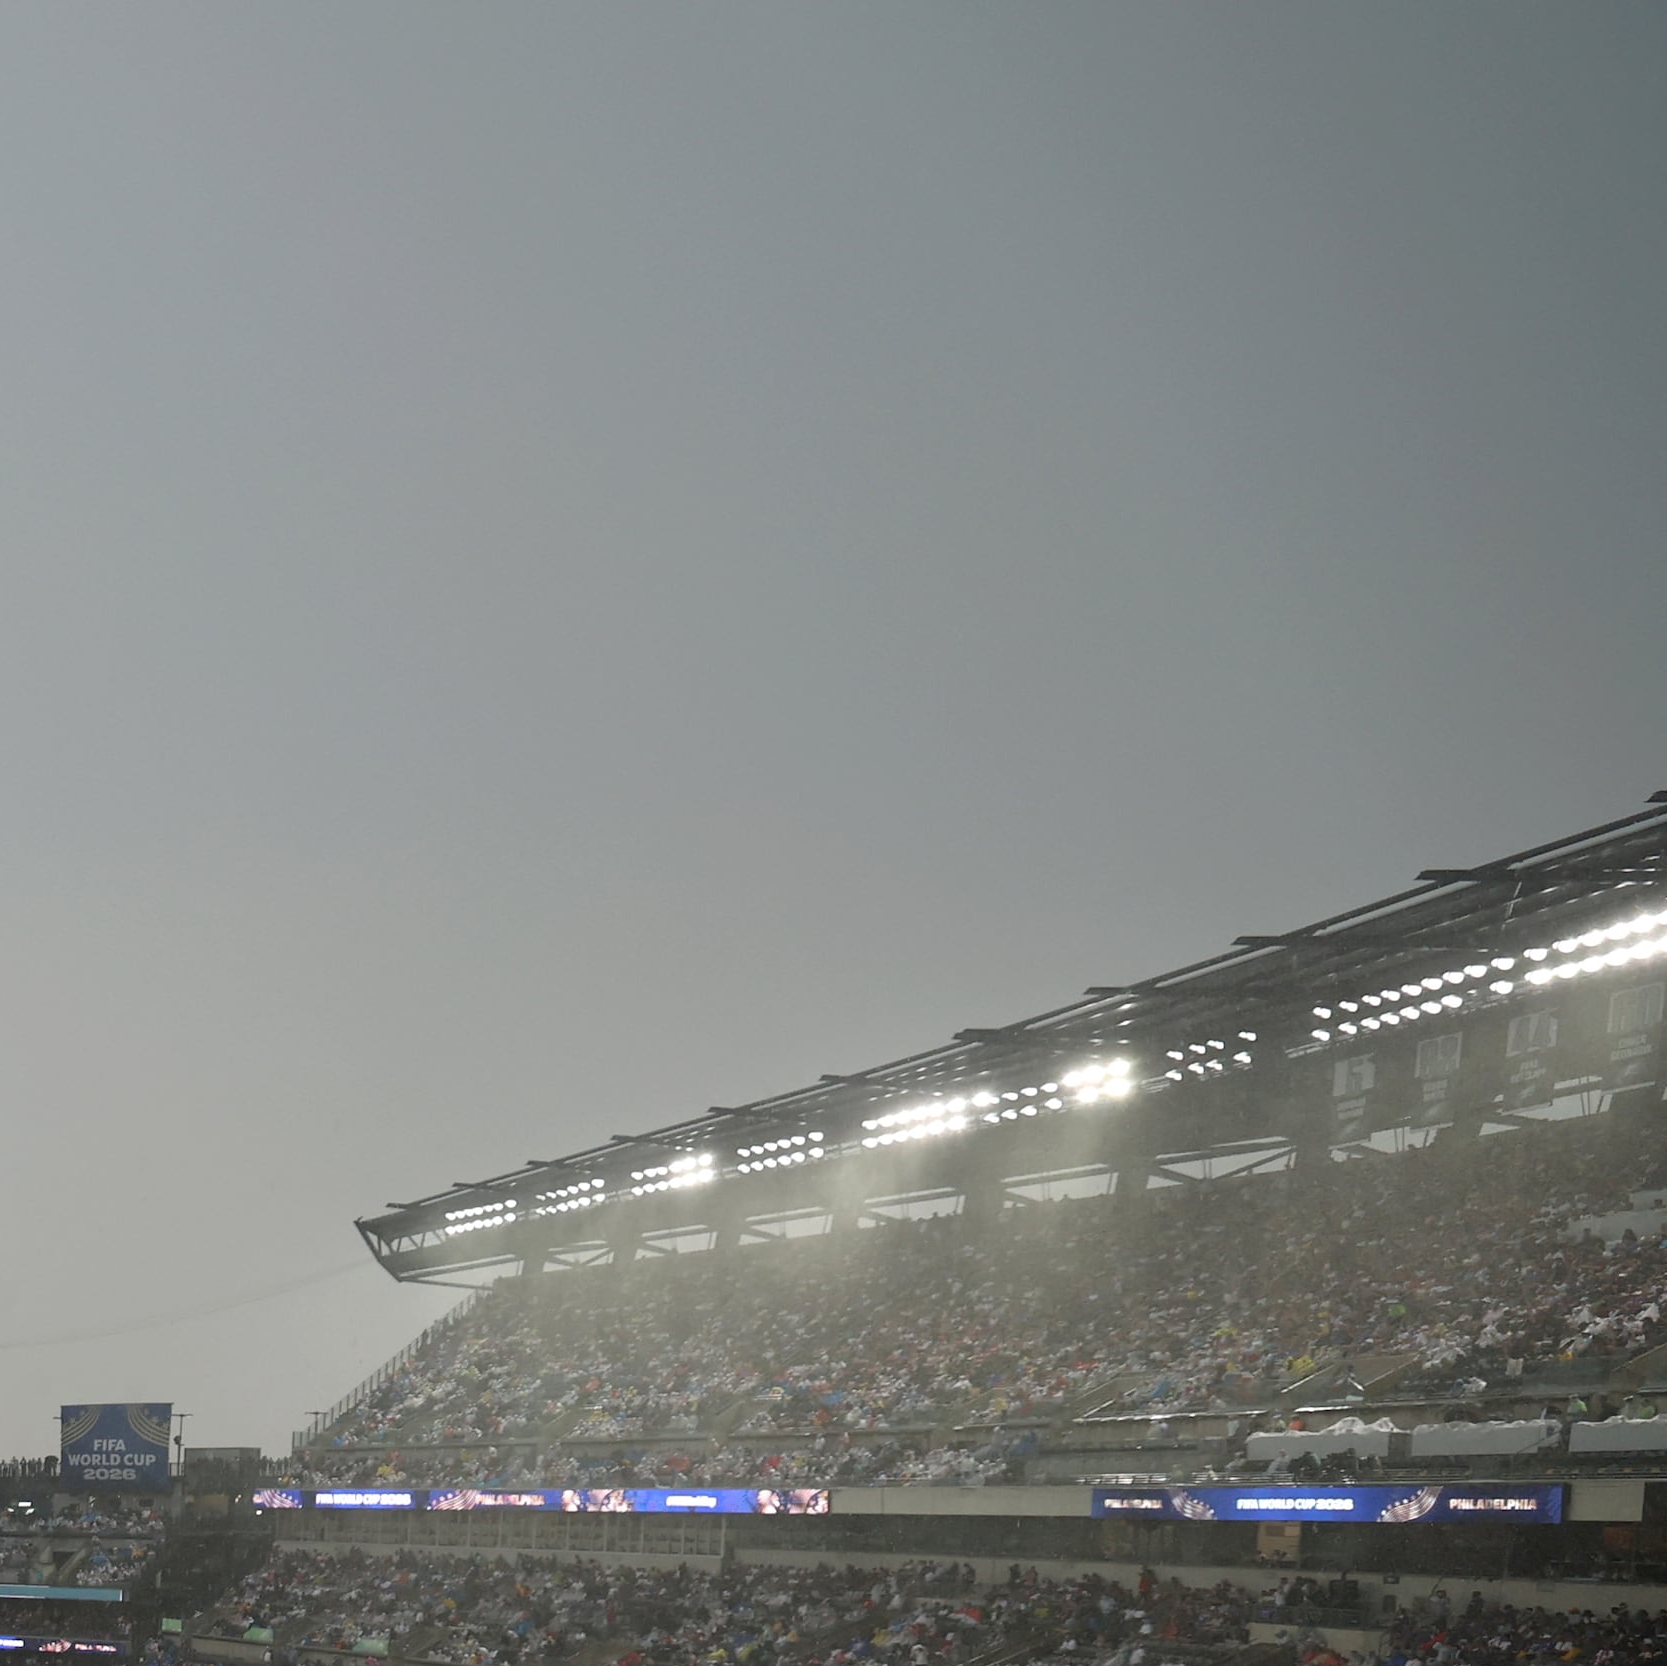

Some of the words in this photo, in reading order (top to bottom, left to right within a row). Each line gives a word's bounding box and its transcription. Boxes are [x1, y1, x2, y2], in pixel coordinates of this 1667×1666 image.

[94, 1439, 126, 1452] FIFA
[68, 1453, 124, 1467] WORLD
[126, 1453, 157, 1467] CUP
[83, 1468, 137, 1481] 2026
[1236, 1499, 1258, 1510] FIFA
[1258, 1499, 1294, 1510] WORLD
[1295, 1499, 1315, 1510] CUP
[1315, 1499, 1354, 1511] 2026
[1449, 1499, 1537, 1510] PHILADELPHIA
